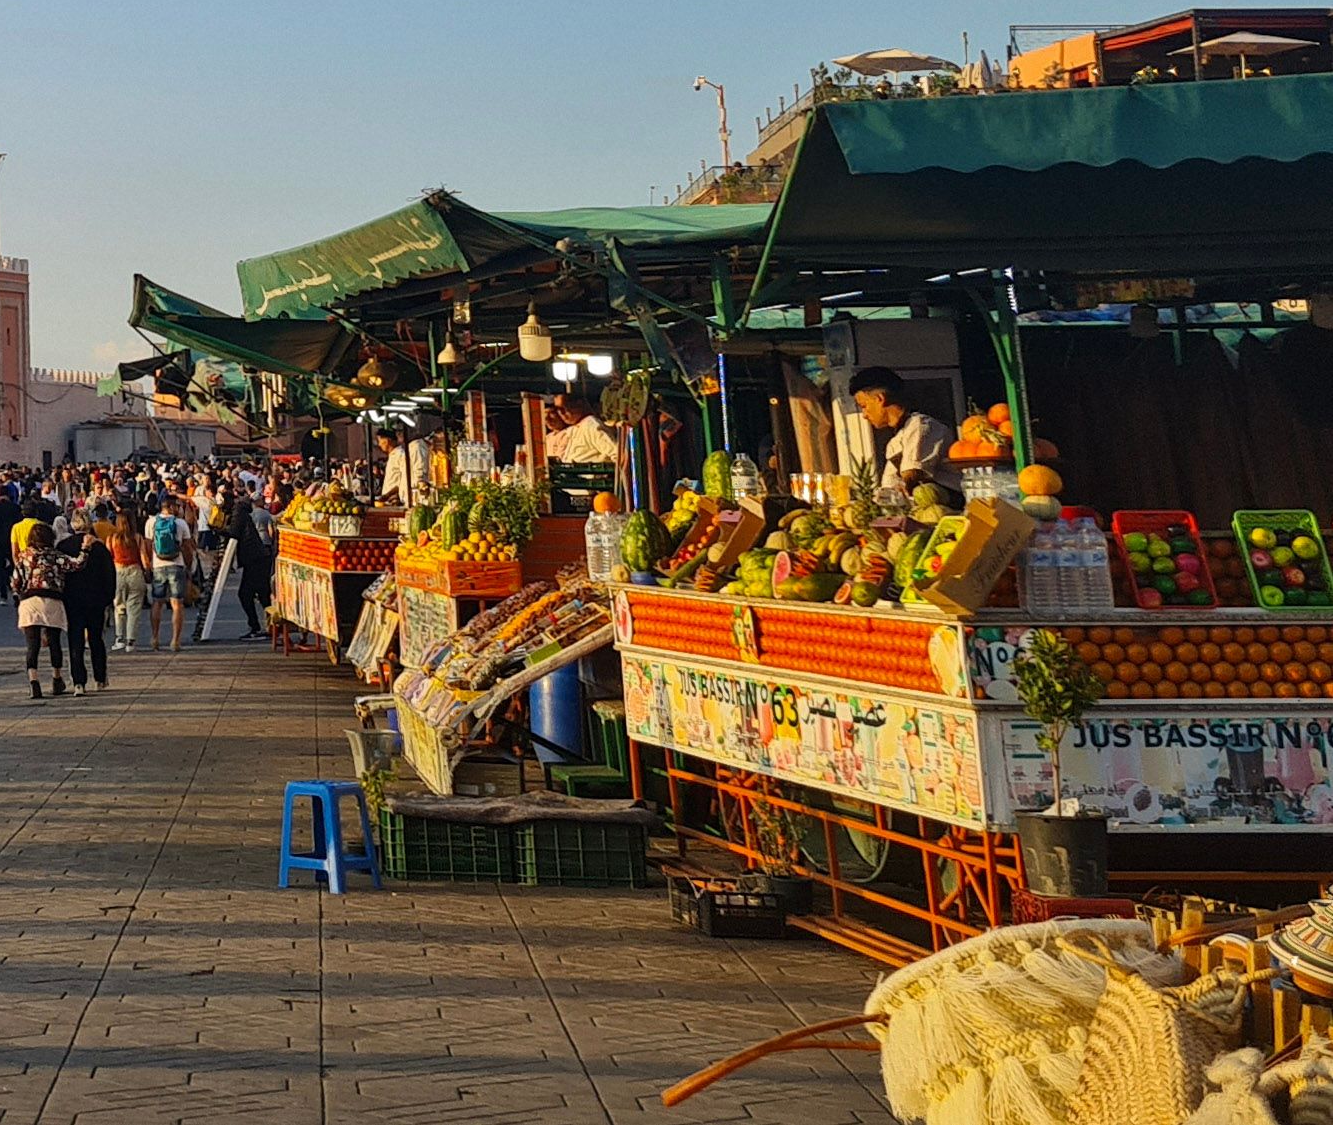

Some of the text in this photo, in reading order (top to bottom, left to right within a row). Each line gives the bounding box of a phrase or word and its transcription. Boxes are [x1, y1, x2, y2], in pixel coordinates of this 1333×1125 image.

[678, 669, 697, 697] JUS
[700, 673, 744, 706] BASSIR
[1073, 723, 1132, 749] JUS
[1143, 723, 1269, 748] BASSIR
